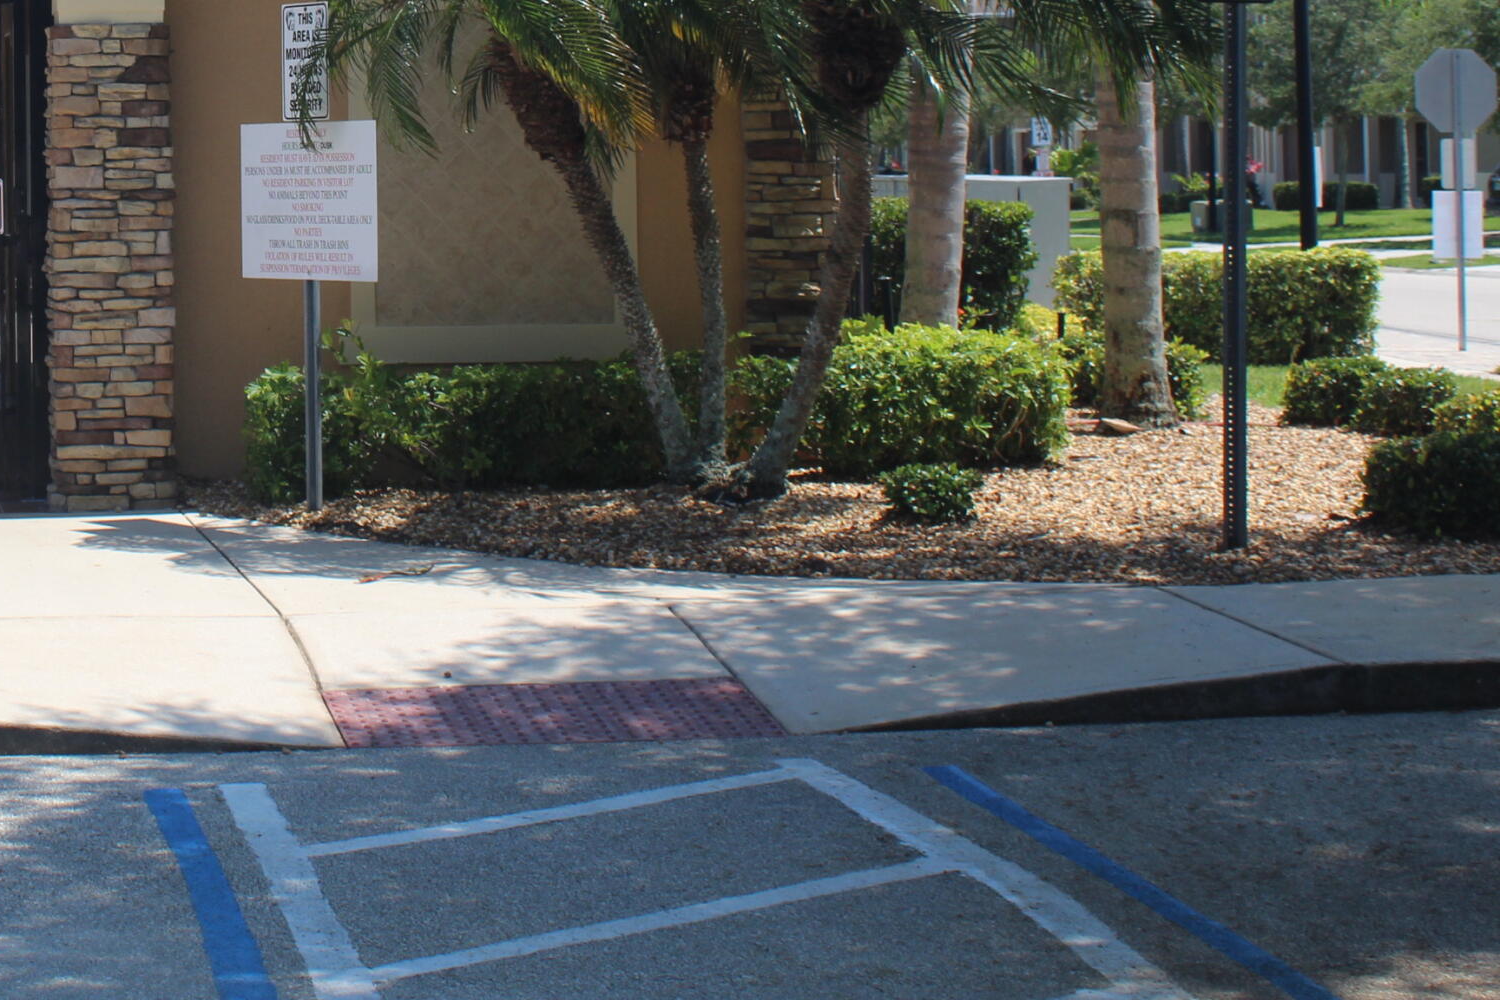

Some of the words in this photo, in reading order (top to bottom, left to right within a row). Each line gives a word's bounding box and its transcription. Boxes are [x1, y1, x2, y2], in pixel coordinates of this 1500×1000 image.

[298, 12, 313, 24] THIS
[292, 31, 310, 42] AREA
[289, 65, 297, 77] 24
[320, 142, 332, 150] DUSK
[269, 190, 275, 200] NO
[299, 190, 320, 199] BEYOND
[321, 190, 332, 199] THIS
[333, 190, 348, 199] POINT
[292, 203, 299, 212] NO
[299, 203, 324, 212] SMOKING
[269, 240, 286, 249] THROW
[286, 240, 296, 249] ALL
[296, 240, 313, 249] TRASH
[314, 240, 319, 249] IN
[320, 240, 337, 249] TRASH
[337, 240, 349, 249] BINS
[265, 252, 290, 261] VIOLATION
[291, 252, 297, 261] OF
[298, 252, 315, 261] RULES
[315, 252, 328, 261] WILL
[328, 252, 347, 261] RESULT
[348, 252, 354, 261] IN
